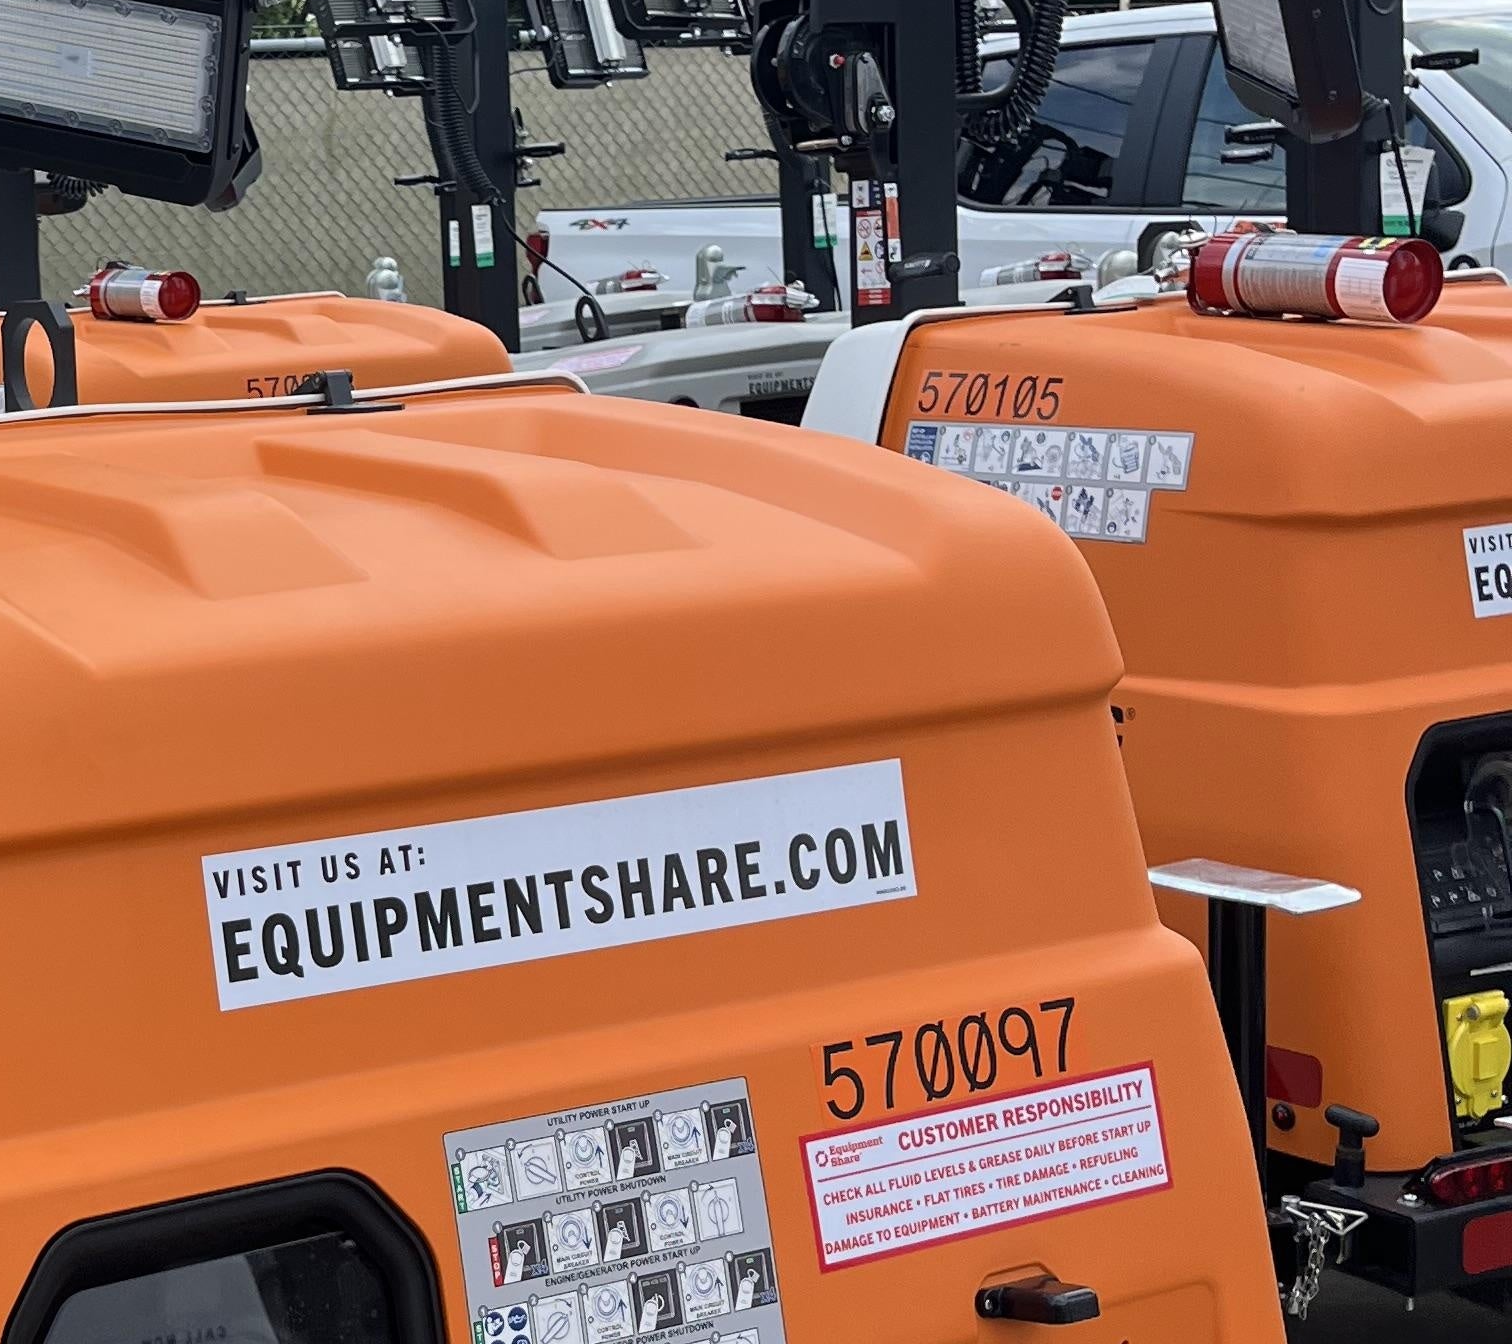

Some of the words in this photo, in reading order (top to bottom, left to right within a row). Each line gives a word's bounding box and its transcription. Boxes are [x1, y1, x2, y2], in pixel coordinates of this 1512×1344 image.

[918, 371, 1064, 420] 570105
[213, 860, 302, 899] VISIT
[320, 851, 361, 884] US
[379, 842, 427, 876] AT:
[221, 819, 905, 983] EQUIPMENTSHARE.COM
[823, 997, 1075, 1120] 570097
[546, 1113, 576, 1126] UTILITY
[579, 1107, 609, 1120] POWER
[610, 1102, 636, 1114] START
[639, 1099, 650, 1109] UP
[897, 1111, 998, 1151] CUSTOMER
[1002, 1079, 1144, 1128] RESPONSIBILITY
[822, 1185, 863, 1206] CHECK
[864, 1180, 886, 1196] ALL
[888, 1172, 921, 1191] FLUID
[924, 1162, 966, 1182] LEVELS
[967, 1160, 976, 1172] &
[978, 1149, 1022, 1170] GREASE
[1024, 1142, 1055, 1159] DAILY
[1057, 1132, 1099, 1152] BEFORE
[1101, 1124, 1134, 1142] START
[1136, 1120, 1151, 1134] UP
[828, 1134, 883, 1156] Equipment
[830, 1152, 860, 1167] Share
[452, 1164, 467, 1212] START
[555, 1191, 586, 1204] UTILITY
[587, 1185, 617, 1198] POWER
[619, 1174, 666, 1191] SHUTDOWN
[825, 1232, 873, 1254] DAMAGE
[876, 1227, 891, 1242] TO
[893, 1211, 961, 1238] EQUIPMENT
[971, 1197, 1020, 1219] BATTERY
[1022, 1178, 1101, 1207] MAINTENANCE
[1111, 1163, 1164, 1186] CLEANING
[845, 1198, 913, 1225] INSURANCE
[923, 1190, 950, 1207] FLAT
[951, 1181, 985, 1200] TIRES
[995, 1173, 1021, 1190] TIRE
[1022, 1162, 1069, 1183] DAMAGE
[1079, 1146, 1138, 1170] REFUELING
[490, 1243, 501, 1279] STOP
[544, 1261, 628, 1286] ENGINE/GENERATOR
[630, 1254, 660, 1268] POWER
[662, 1248, 687, 1261] START
[689, 1245, 700, 1254] UP
[635, 1331, 665, 1344] POWER
[667, 1319, 714, 1338] SHUTDOWN
